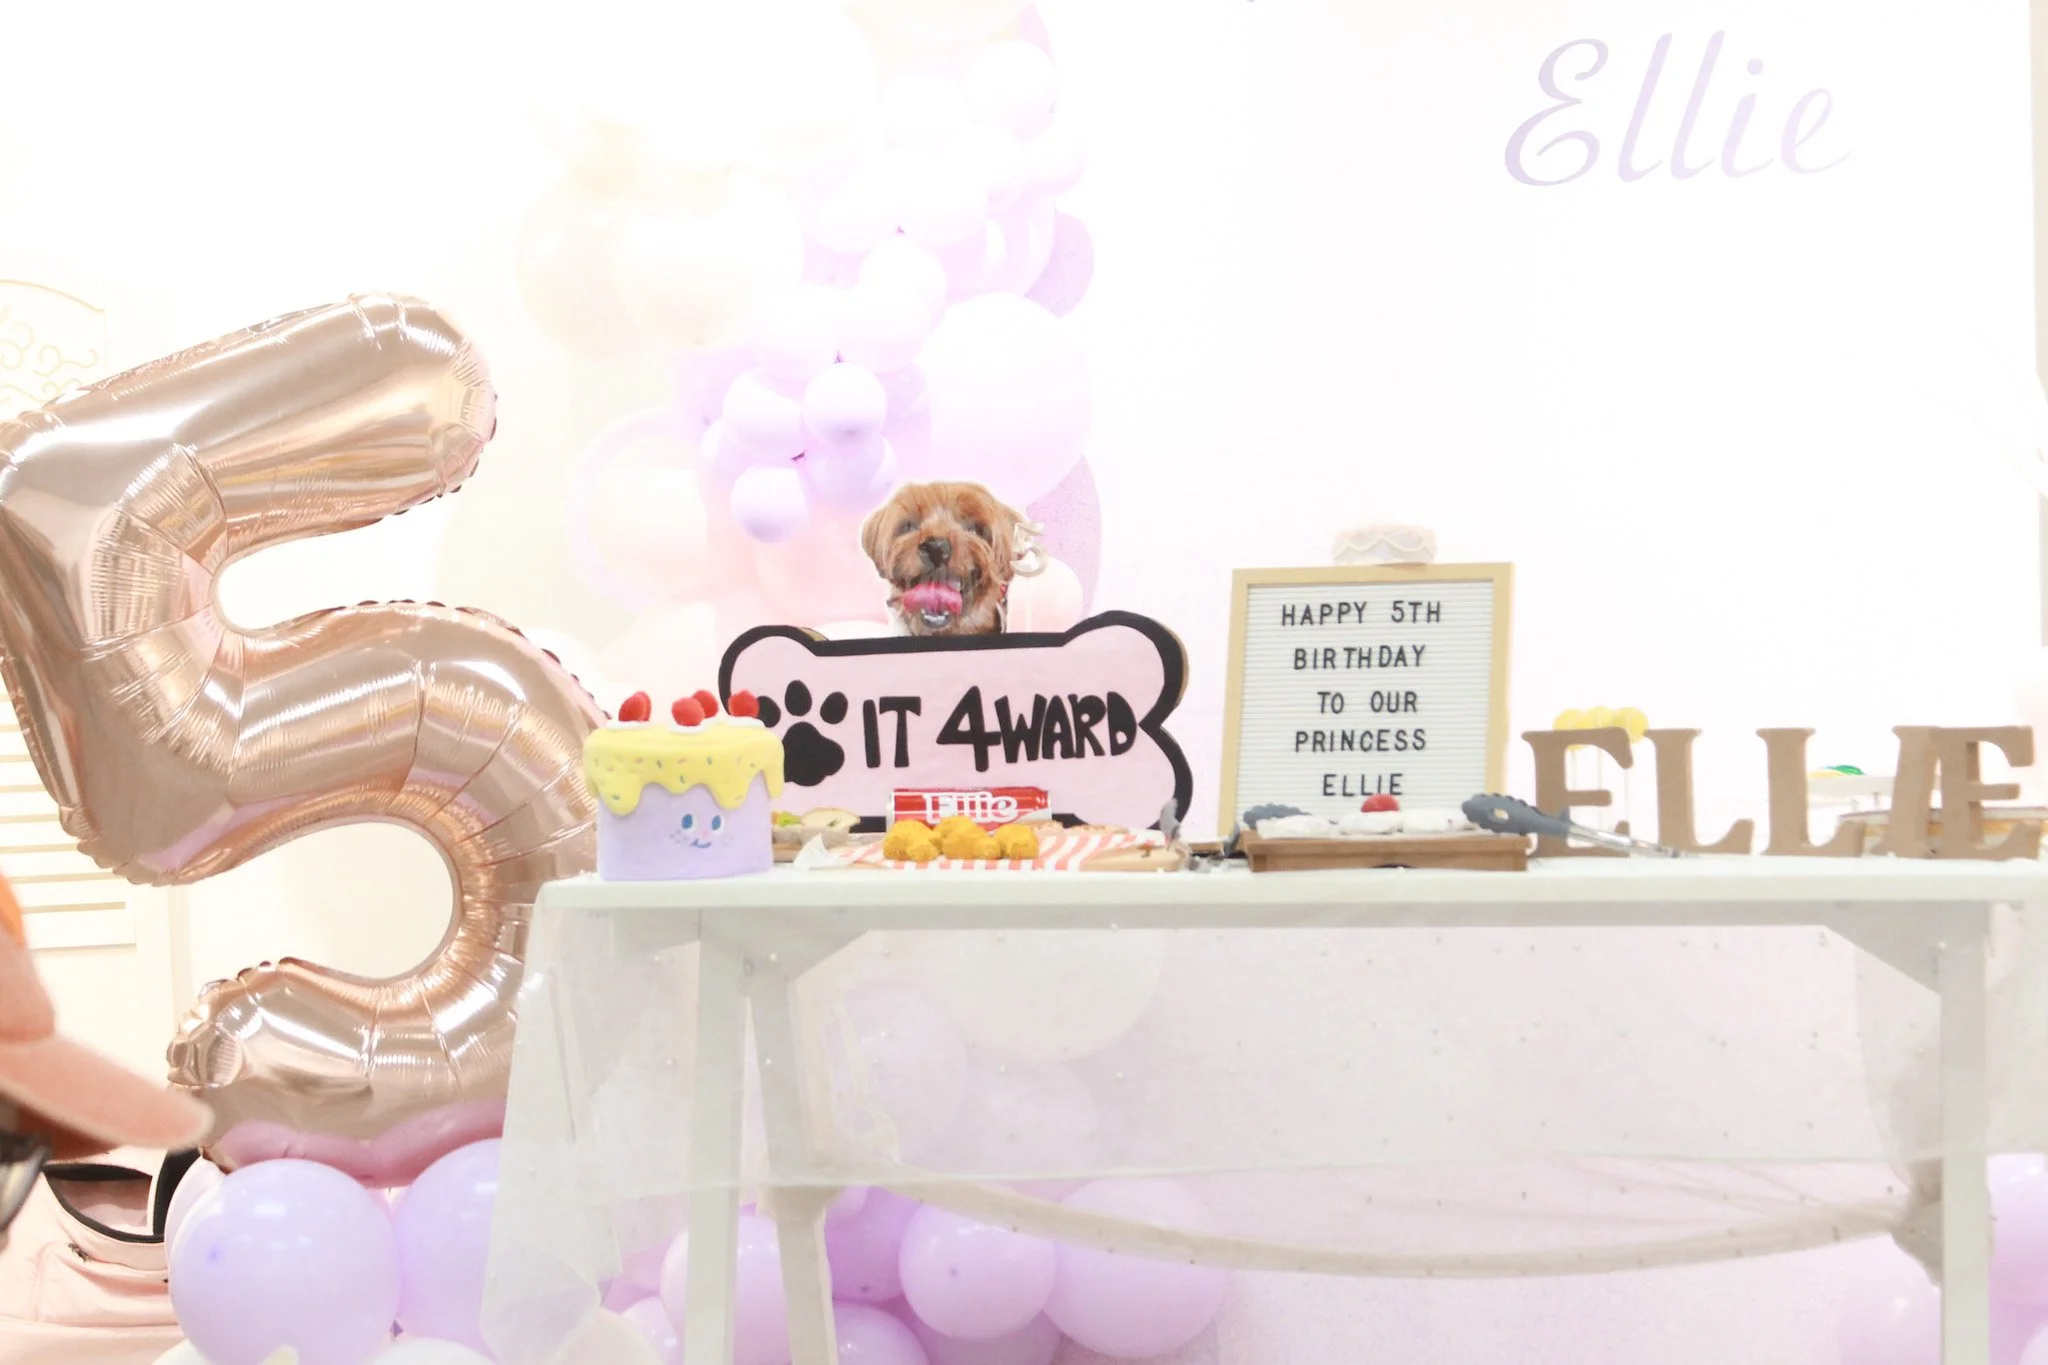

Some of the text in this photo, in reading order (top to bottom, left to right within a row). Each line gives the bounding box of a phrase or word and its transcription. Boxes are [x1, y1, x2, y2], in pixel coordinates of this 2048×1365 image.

[1505, 30, 1851, 186] Ellie
[1009, 521, 1049, 578] 5
[1281, 600, 1441, 626] HAPPY 5TH
[1293, 645, 1425, 670] BIRTHDAY
[1317, 691, 1418, 714] TO OUR
[0, 290, 602, 1188] 5
[863, 686, 1137, 772] IT 4WARD
[1295, 729, 1427, 752] PRINCESS
[1323, 773, 1404, 796] ELLIE
[1521, 725, 2035, 861] ELLIE
